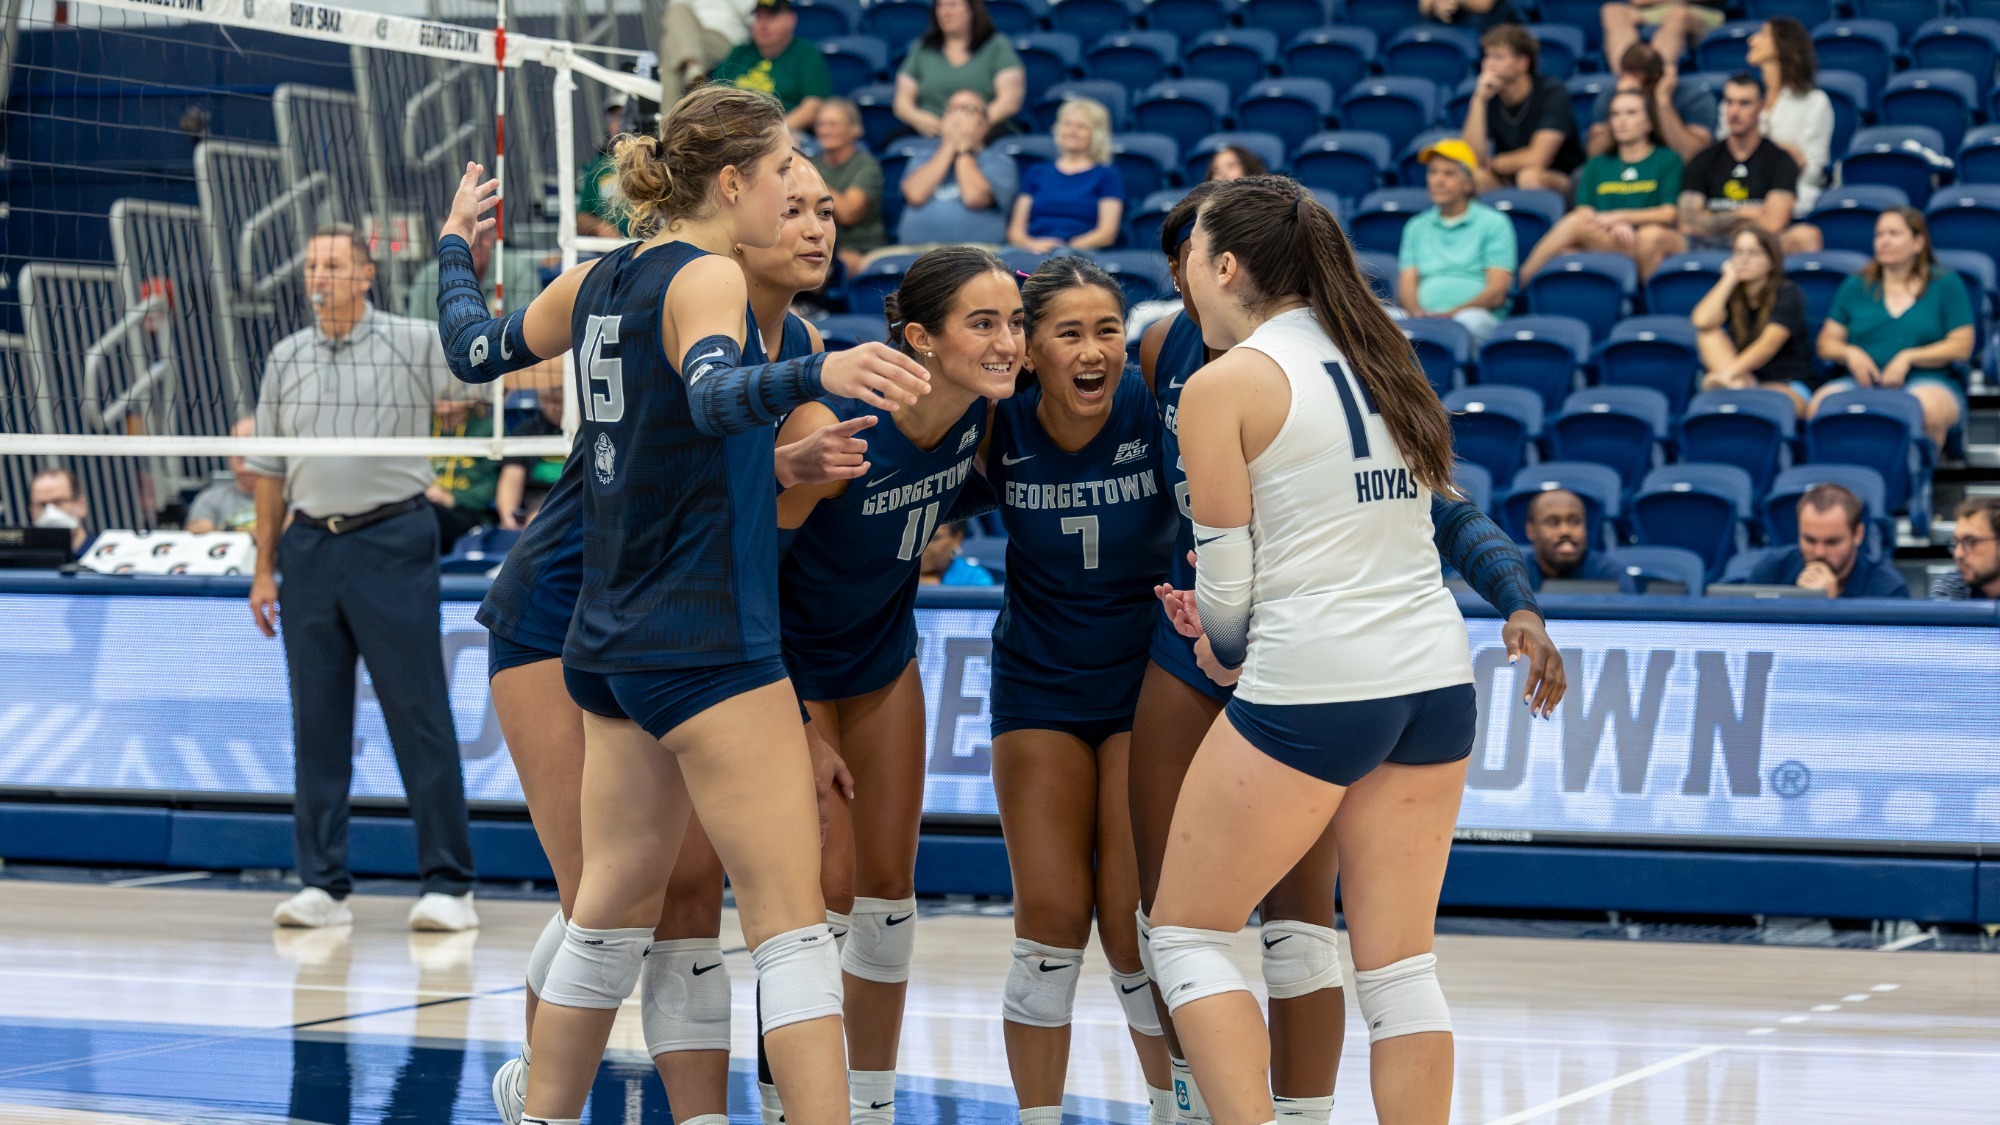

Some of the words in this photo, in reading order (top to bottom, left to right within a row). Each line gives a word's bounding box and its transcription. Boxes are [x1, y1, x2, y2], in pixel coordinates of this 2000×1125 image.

[420, 23, 479, 53] GEORGETOWN
[580, 314, 625, 423] 15
[1113, 444, 1149, 461] EAST
[1117, 438, 1142, 453] BIG
[862, 455, 973, 516] GEORGETOW
[1005, 469, 1158, 510] GEORGETOWN
[1354, 468, 1418, 503] HOYAS
[896, 501, 940, 561] 11
[1060, 515, 1099, 570] 7
